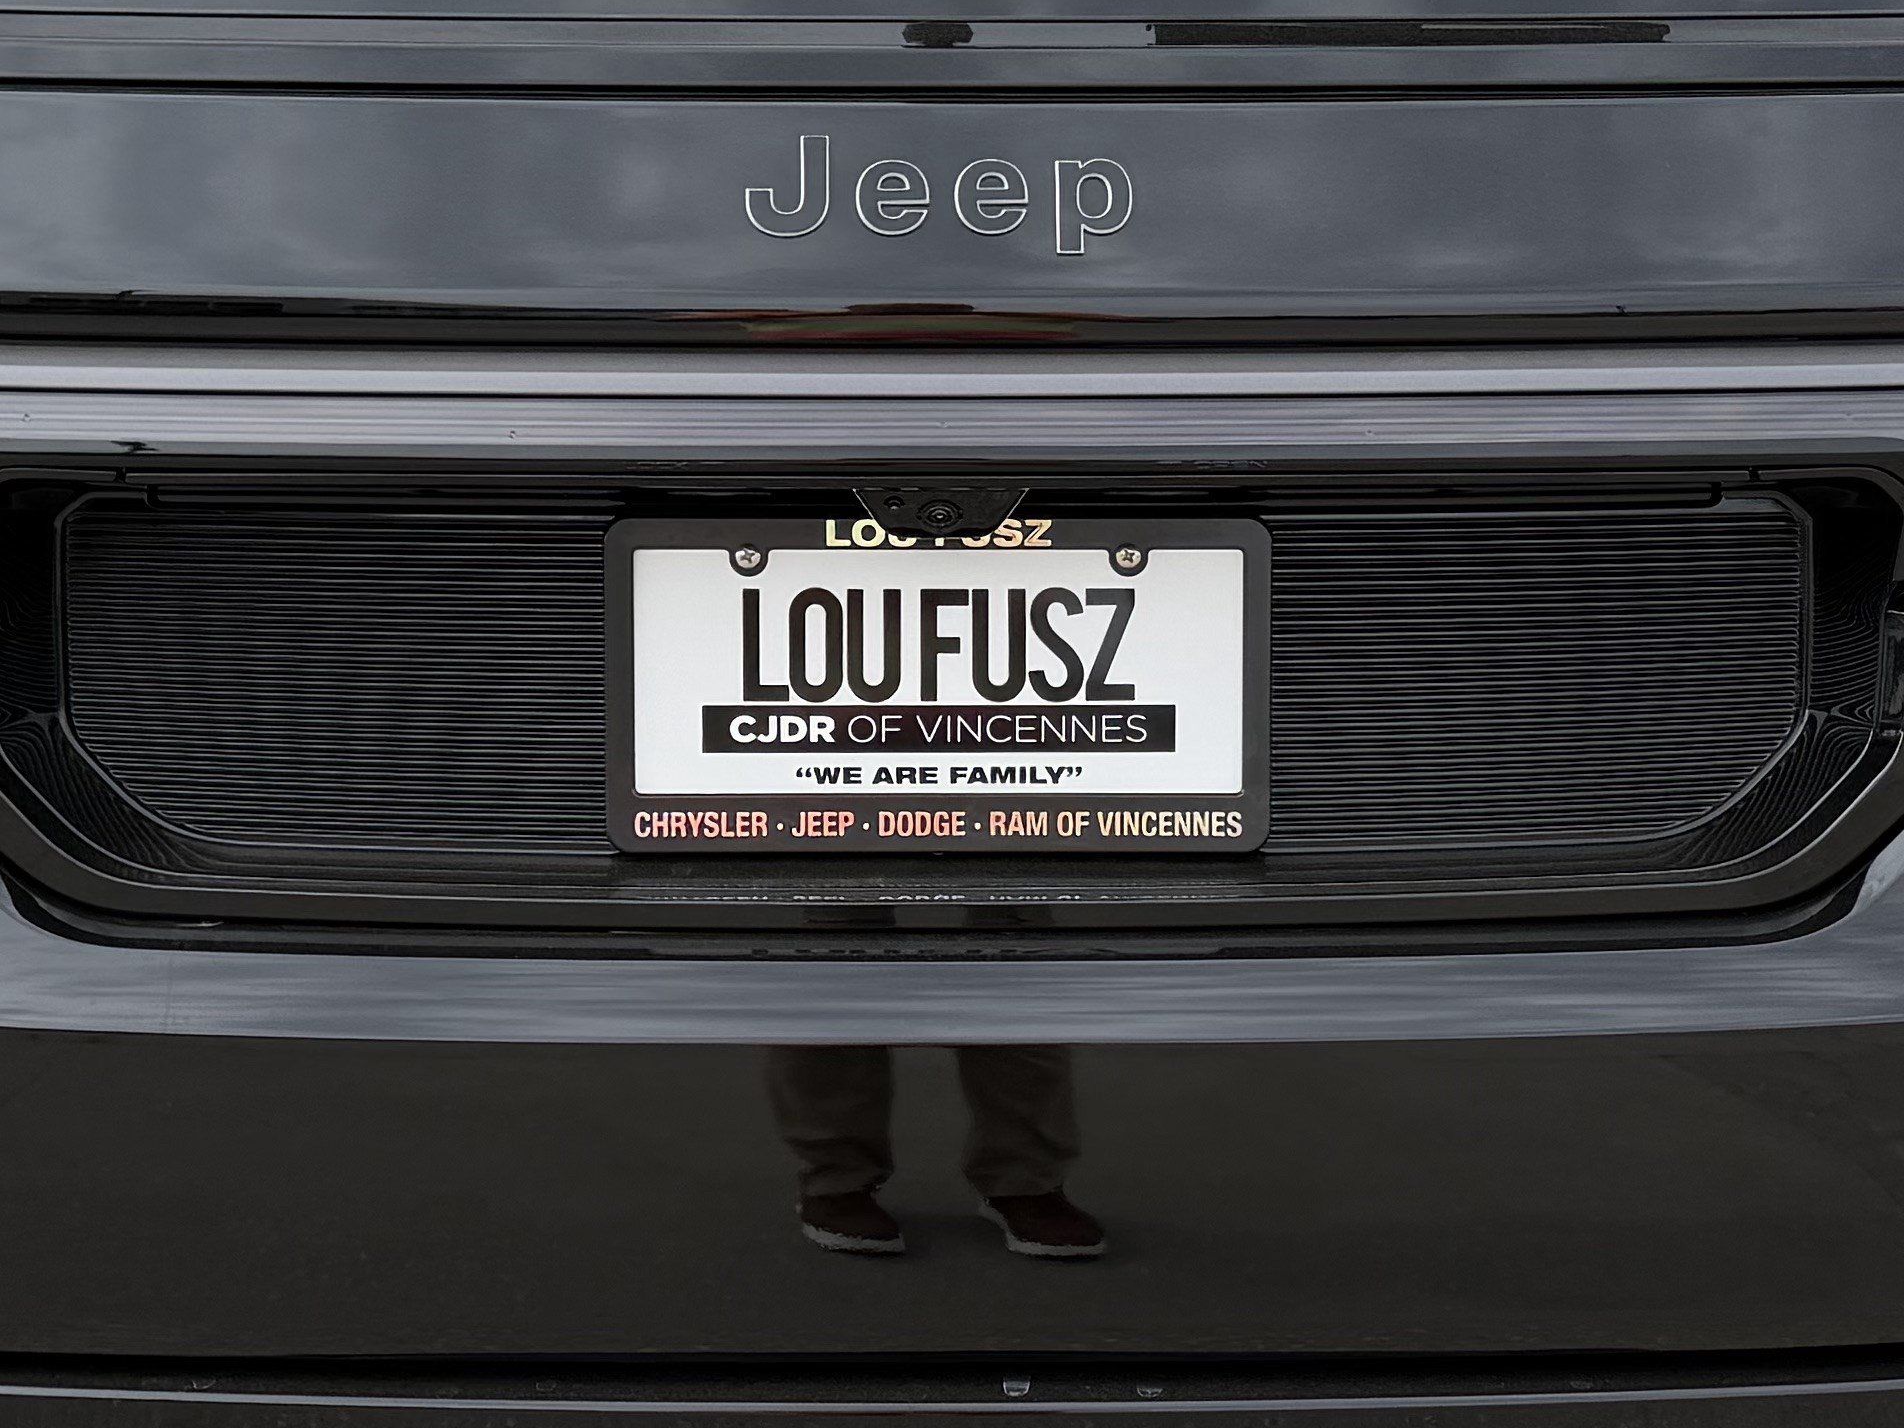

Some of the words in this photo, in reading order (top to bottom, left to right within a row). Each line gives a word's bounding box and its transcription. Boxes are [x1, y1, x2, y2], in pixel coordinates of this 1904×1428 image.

[745, 134, 1133, 254] Jeep
[934, 518, 1052, 548] SZ
[742, 587, 902, 703] LOU
[920, 587, 1136, 703] FUSZ
[729, 714, 836, 744] CJDR
[847, 714, 903, 744] OF
[916, 714, 1148, 744] VINCENNES
[872, 765, 939, 785] ARE
[634, 811, 768, 838] CHRYSLER
[791, 811, 855, 837] JEEP
[878, 811, 967, 837] DODGE
[989, 811, 1048, 837] RAM
[1056, 811, 1091, 837] OF
[1097, 811, 1243, 838] VINCENNES
